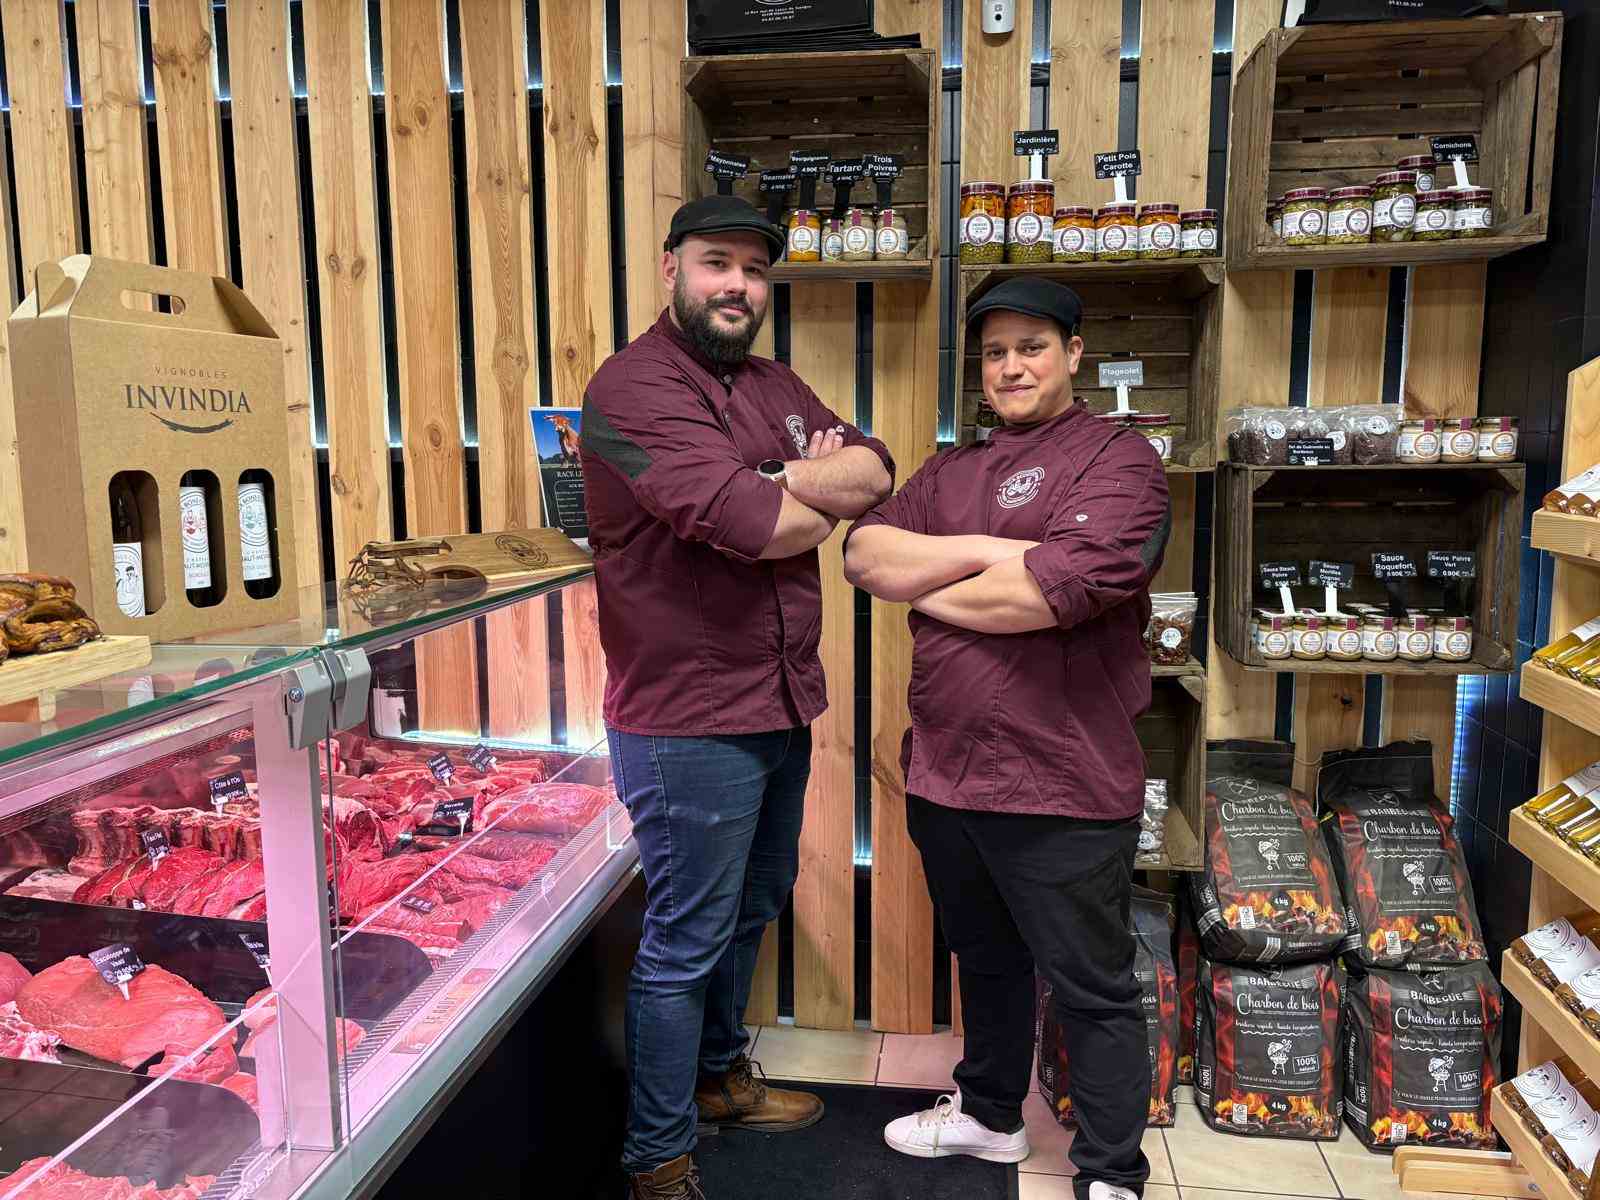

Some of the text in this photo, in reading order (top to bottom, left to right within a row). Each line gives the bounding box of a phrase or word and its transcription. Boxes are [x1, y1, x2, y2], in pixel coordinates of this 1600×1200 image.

[1016, 136, 1056, 144] Jardinière
[873, 154, 893, 163] Trois
[1096, 153, 1137, 163] Petit Pois
[868, 163, 898, 172] Poivres
[1103, 162, 1134, 171] Carotte
[154, 366, 227, 379] VIGNOBLES
[125, 384, 252, 414] INVINDIA
[1381, 554, 1405, 562] Sauce
[1375, 563, 1413, 572] Roquefort
[1222, 802, 1265, 821] Charbon
[1267, 803, 1279, 815] de
[1364, 821, 1440, 841] Charbon de bois
[1280, 898, 1288, 906] kg
[1426, 922, 1435, 932] kg
[1411, 990, 1464, 1005] BARBECUE
[1237, 993, 1319, 1015] Charbon de bois
[1395, 1007, 1482, 1030] Charbon de bois
[1297, 1057, 1316, 1066] 100%
[1202, 1069, 1210, 1088] 100%
[1460, 1073, 1478, 1082] 100%
[1277, 1102, 1287, 1111] kg
[1438, 1119, 1447, 1128] kg
